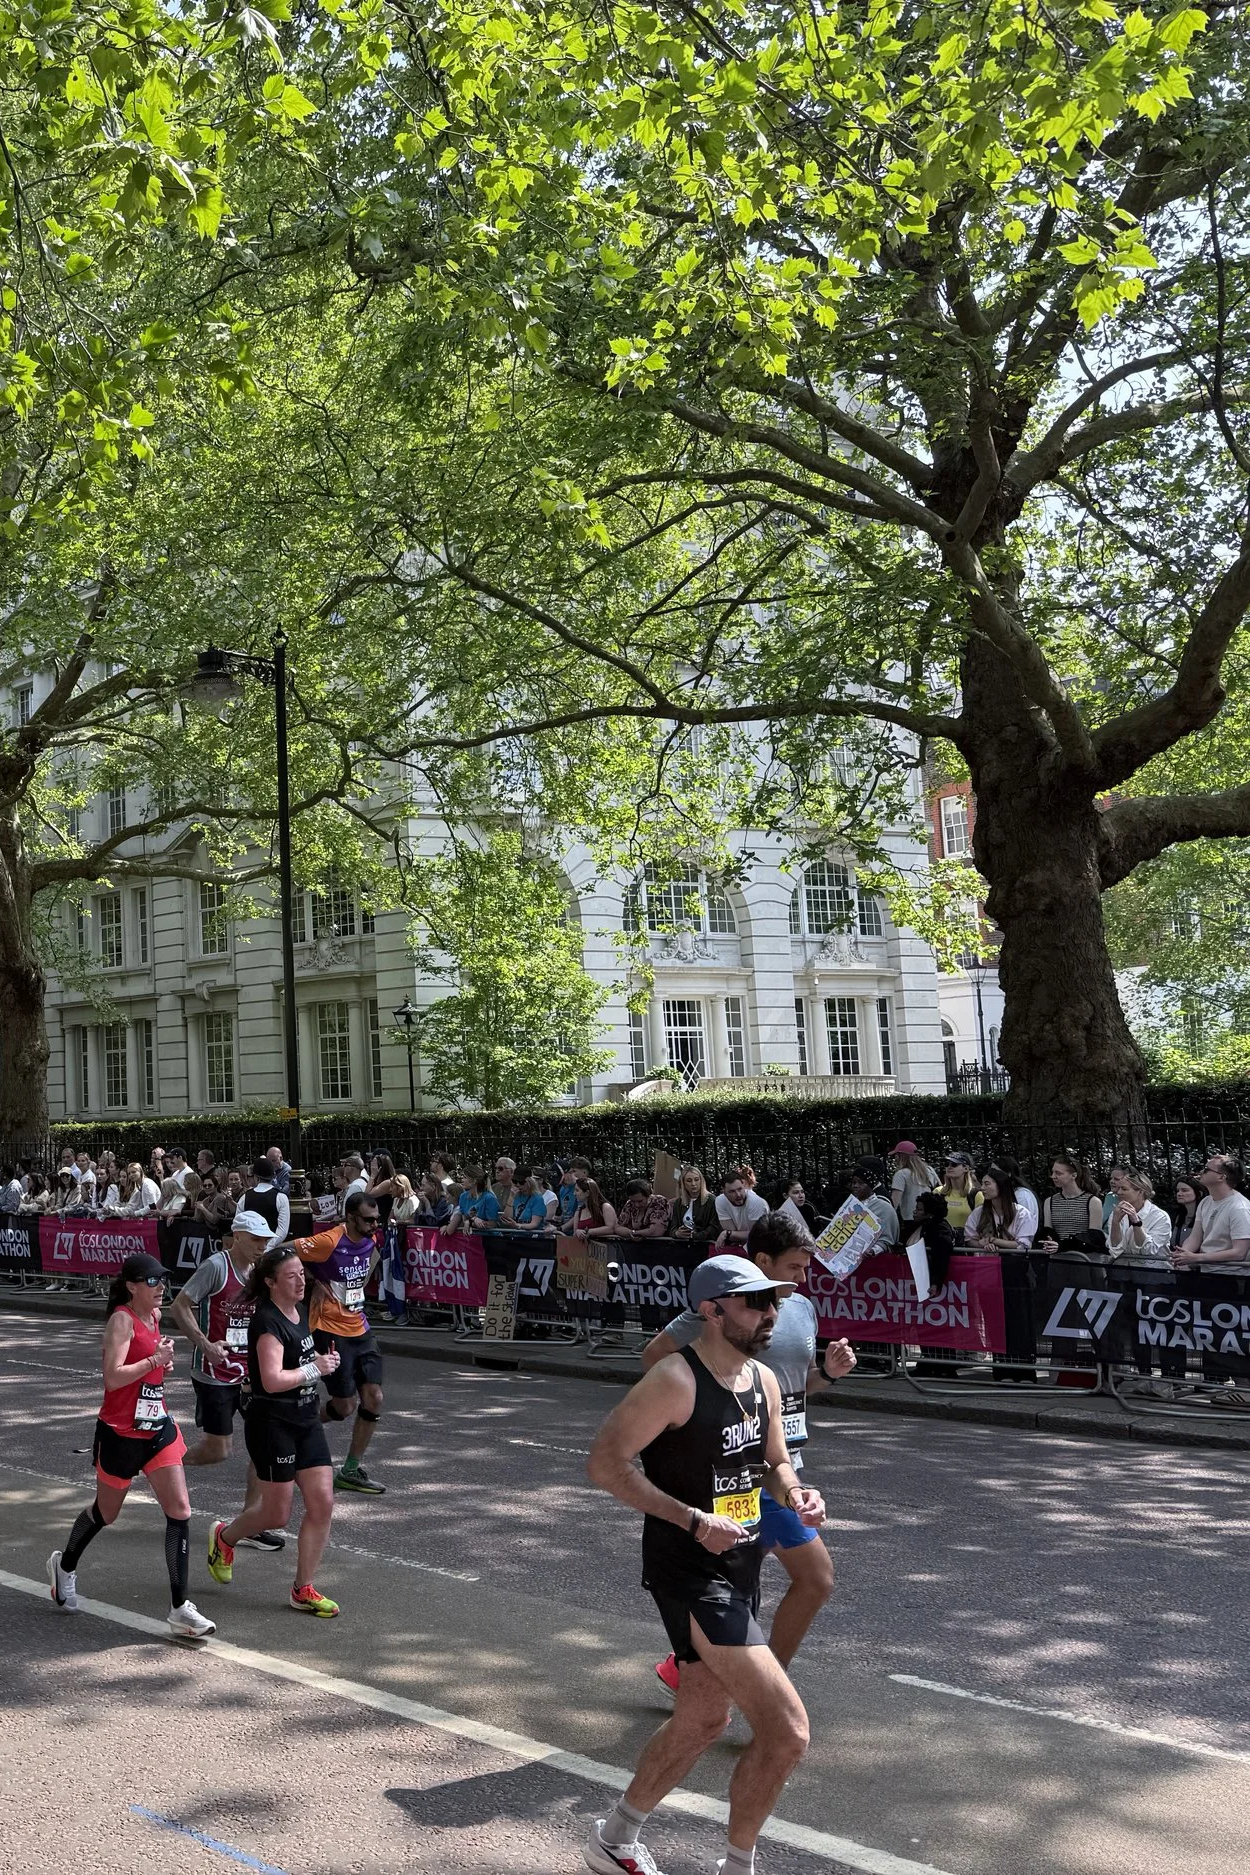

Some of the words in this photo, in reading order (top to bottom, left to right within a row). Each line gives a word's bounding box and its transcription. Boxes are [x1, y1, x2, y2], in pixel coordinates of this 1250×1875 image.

[815, 1216, 843, 1250] KEEP
[208, 1234, 222, 1254] tc
[80, 1248, 146, 1264] MARATH
[406, 1248, 467, 1271] ONDON
[403, 1266, 469, 1289] RATHON
[558, 1273, 585, 1290] SUPER
[606, 1261, 687, 1286] ONDON
[490, 1275, 505, 1298] for
[488, 1302, 500, 1311] it
[810, 1294, 970, 1329] MARATHON
[230, 1316, 242, 1327] tcs
[485, 1317, 497, 1337] Do
[498, 1316, 512, 1340] the
[1138, 1319, 1250, 1356] MARA
[142, 1383, 156, 1398] tcs
[147, 1404, 158, 1417] 79
[714, 1474, 738, 1492] tcs
